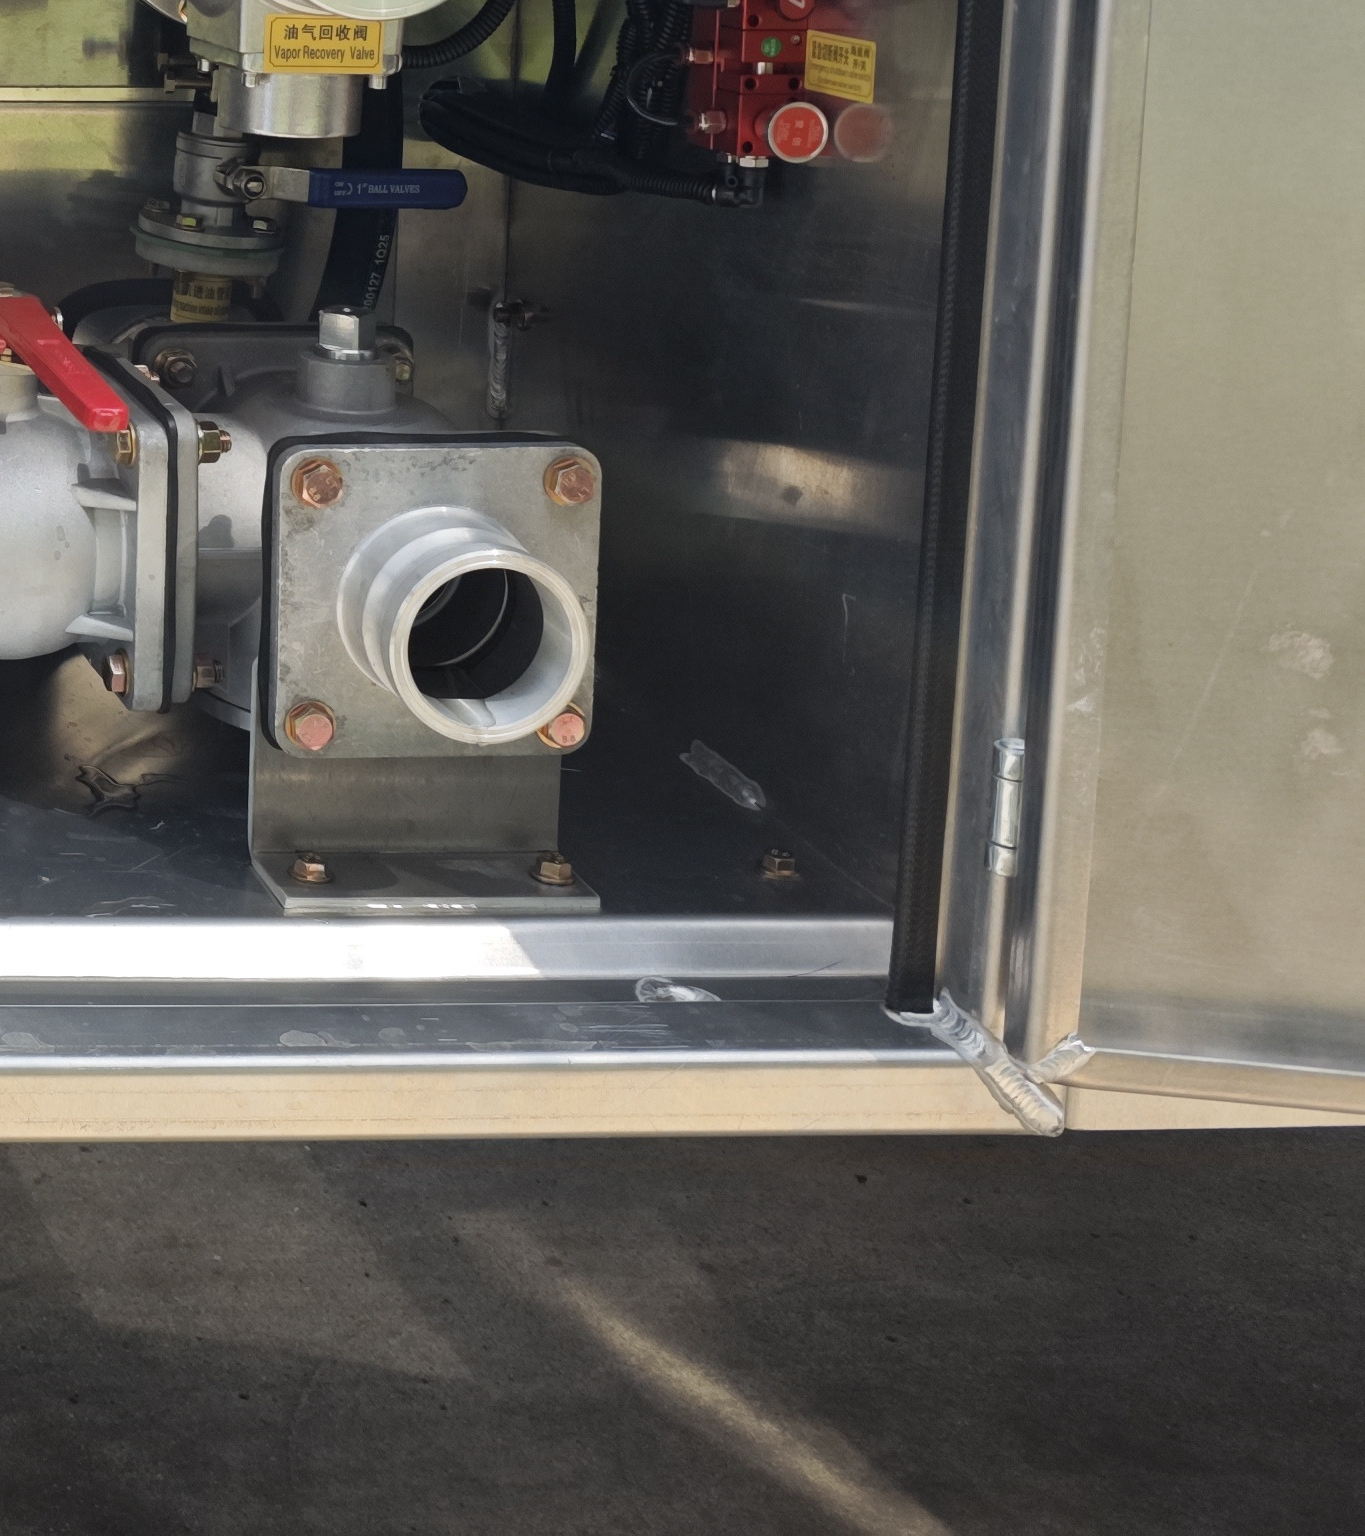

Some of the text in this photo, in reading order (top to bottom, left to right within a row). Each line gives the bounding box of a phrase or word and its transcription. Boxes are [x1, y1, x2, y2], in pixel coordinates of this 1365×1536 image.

[284, 24, 368, 41] 油气回收阀
[274, 45, 375, 63] Vapor Recovery Valve
[368, 184, 388, 194] BALL
[390, 184, 420, 195] VALVES
[374, 234, 389, 265] 1Q25
